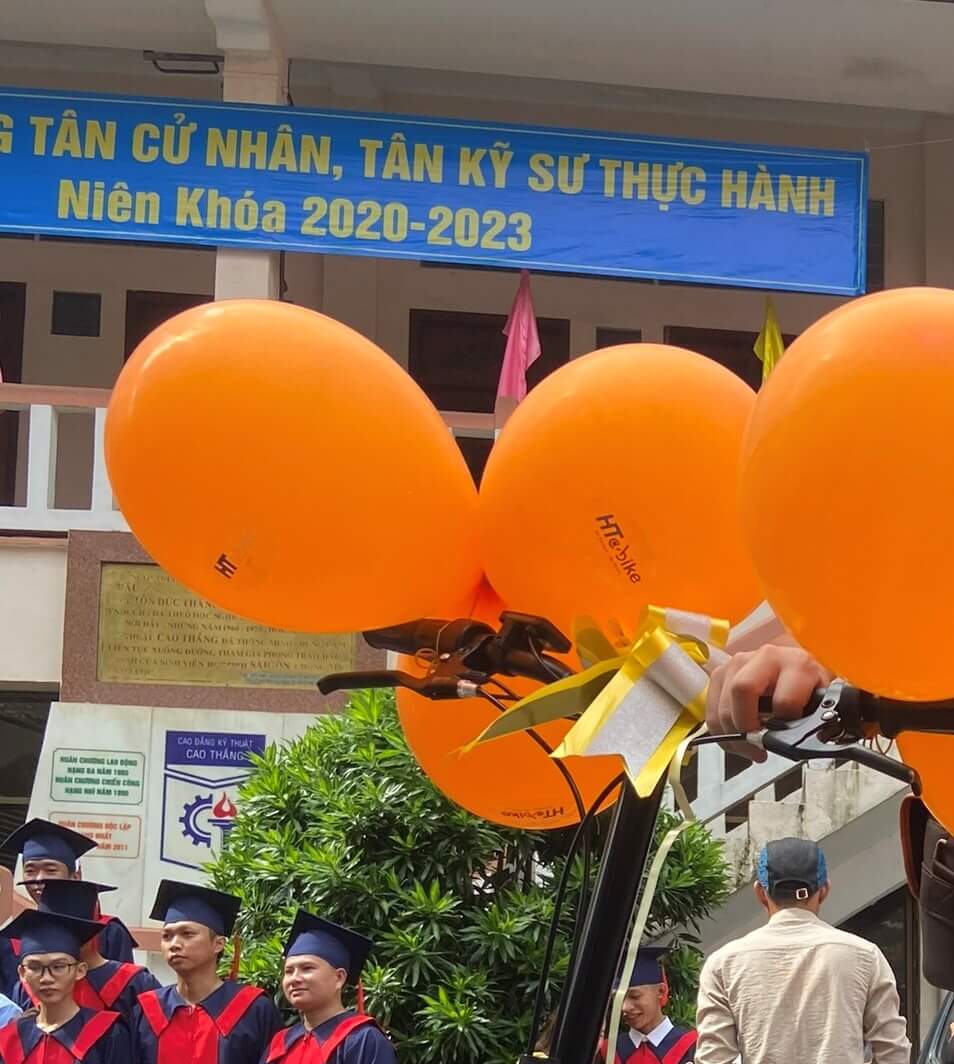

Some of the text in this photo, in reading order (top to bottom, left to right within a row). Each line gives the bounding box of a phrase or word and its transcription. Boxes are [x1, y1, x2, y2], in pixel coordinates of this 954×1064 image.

[29, 109, 117, 160] TÂN
[132, 112, 197, 165] CỬ
[205, 124, 343, 180] NHÂN,
[360, 133, 444, 183] TÂN
[458, 140, 514, 189] KỸ
[528, 152, 591, 195] SƯ
[599, 159, 706, 211] THỰC
[721, 163, 836, 217] HÀNH
[57, 179, 532, 253] Niên Khóa 2020-2023
[186, 749, 206, 759] CAO
